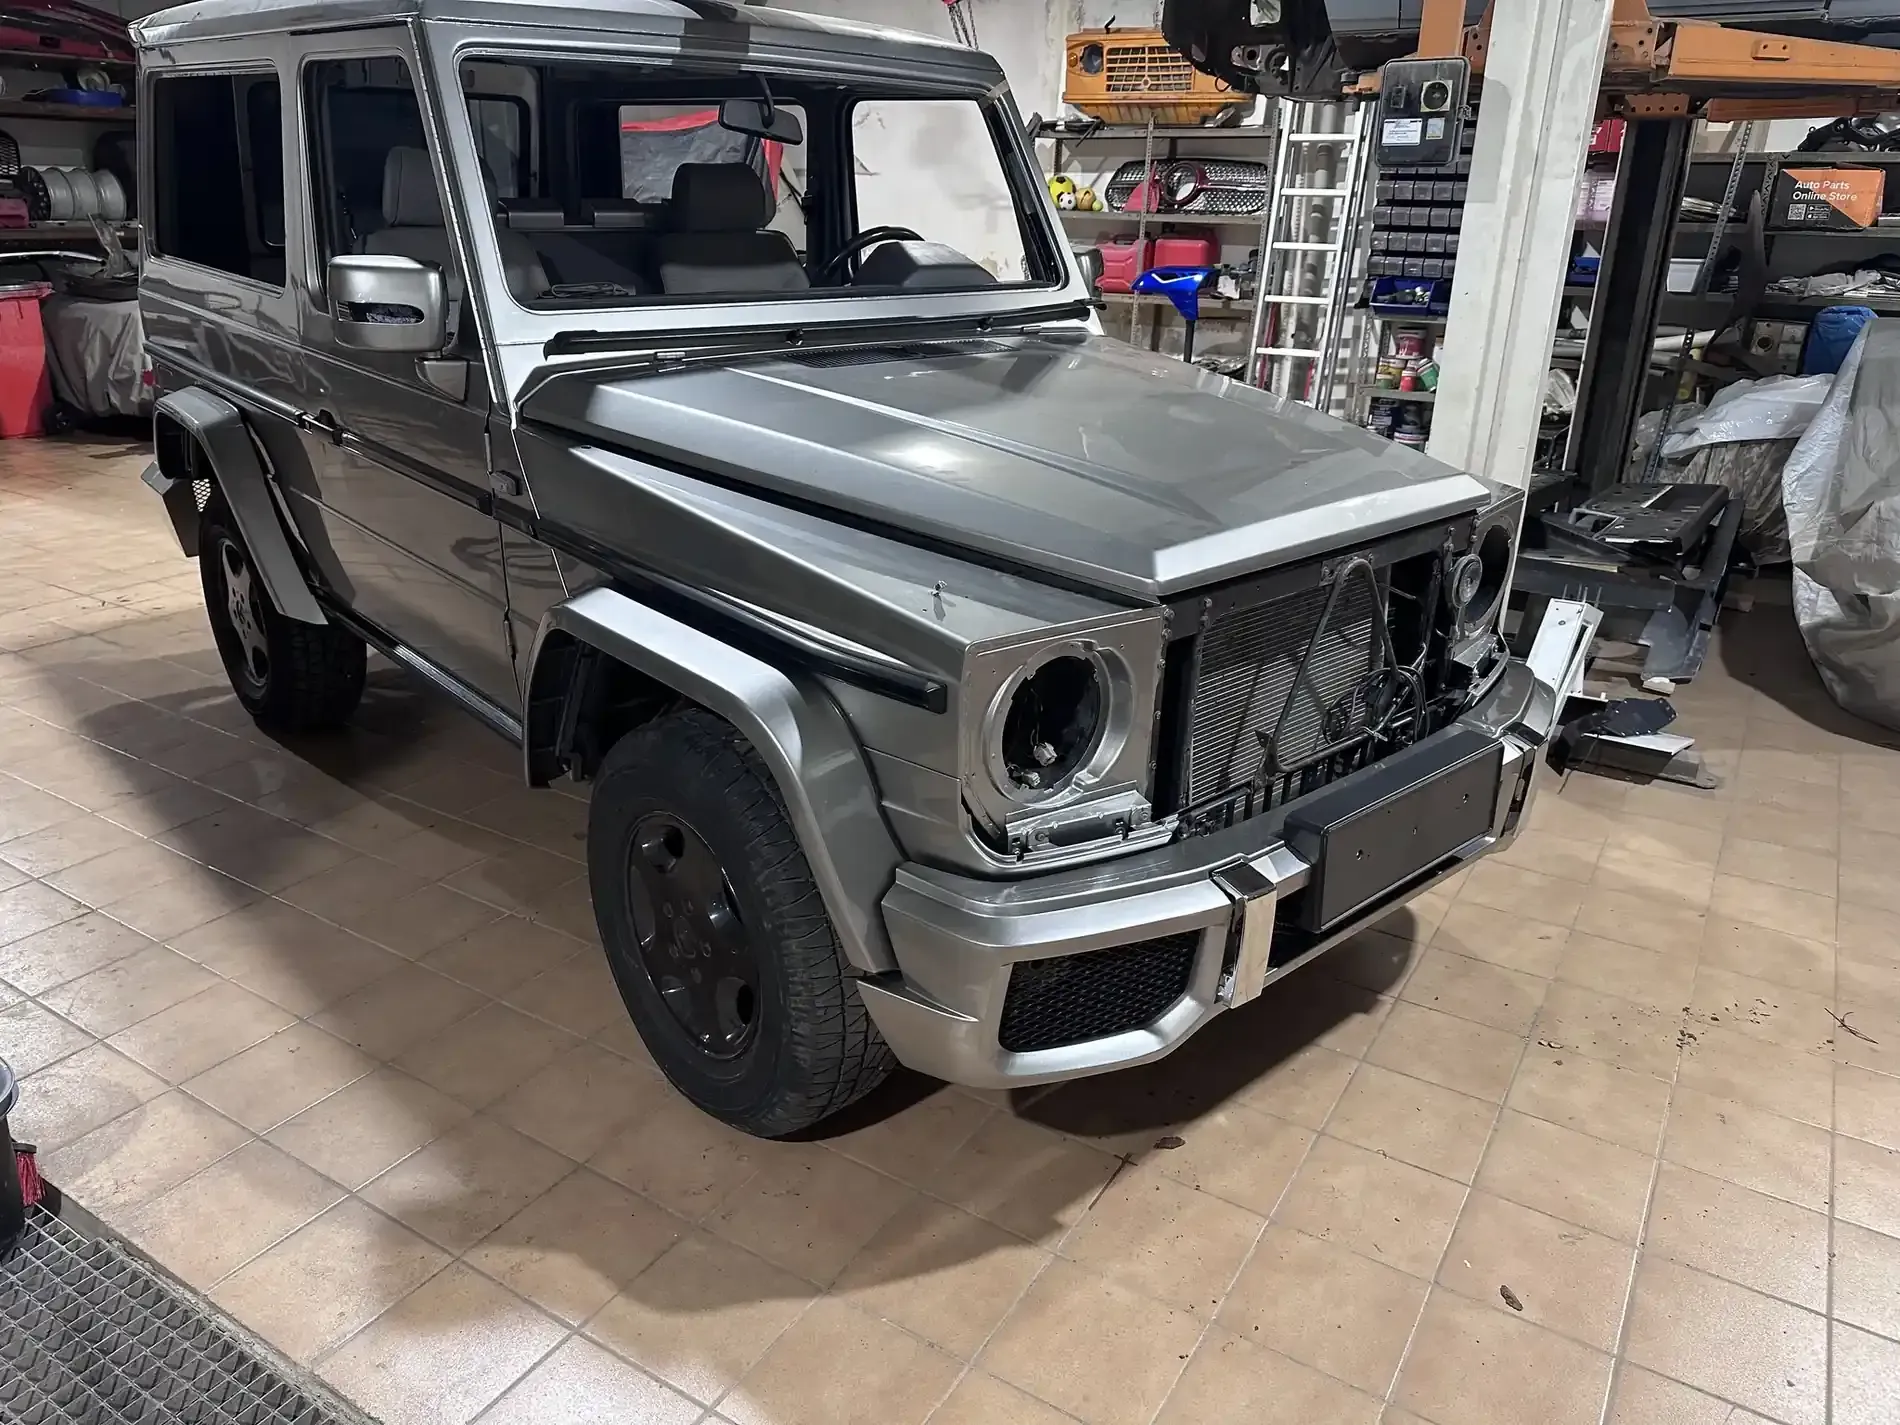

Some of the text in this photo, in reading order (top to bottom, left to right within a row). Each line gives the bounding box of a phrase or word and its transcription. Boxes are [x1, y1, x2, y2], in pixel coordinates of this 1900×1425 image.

[1794, 180, 1850, 190] Auto Parts
[1792, 191, 1858, 201] Online Store
